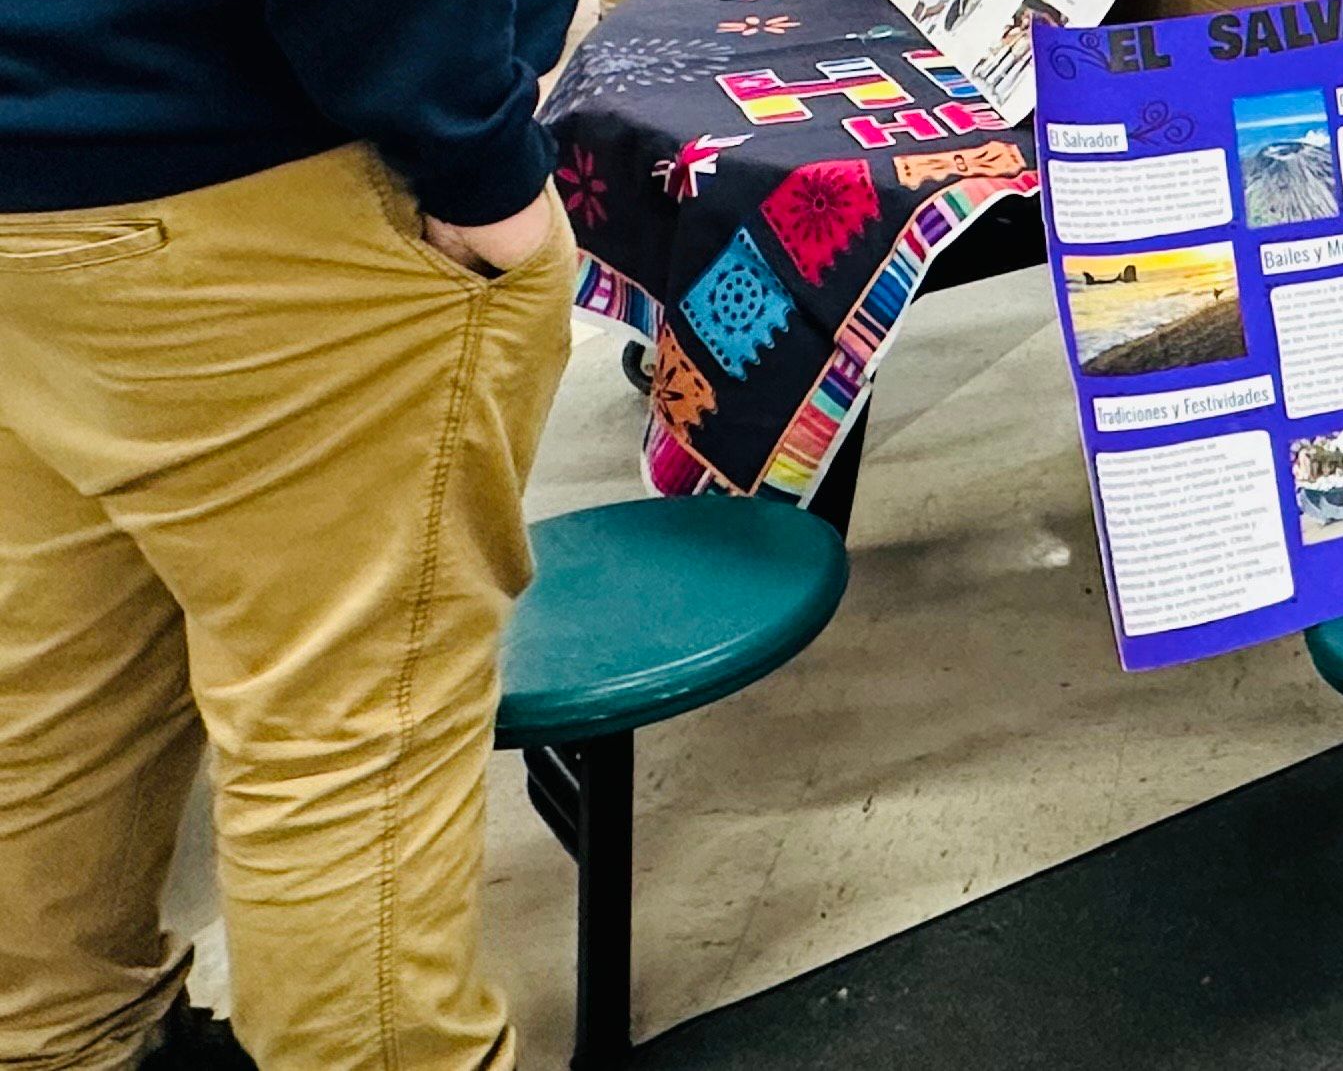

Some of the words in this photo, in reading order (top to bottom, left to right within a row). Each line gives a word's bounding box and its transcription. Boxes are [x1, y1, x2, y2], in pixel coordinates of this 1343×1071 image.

[1105, 24, 1172, 75] EL
[1062, 129, 1120, 148] Salvador
[1264, 248, 1311, 269] Bailes
[1314, 247, 1323, 263] y
[1097, 403, 1169, 426] Tradiciones
[1172, 402, 1180, 418] y
[1184, 387, 1270, 415] Festividades
